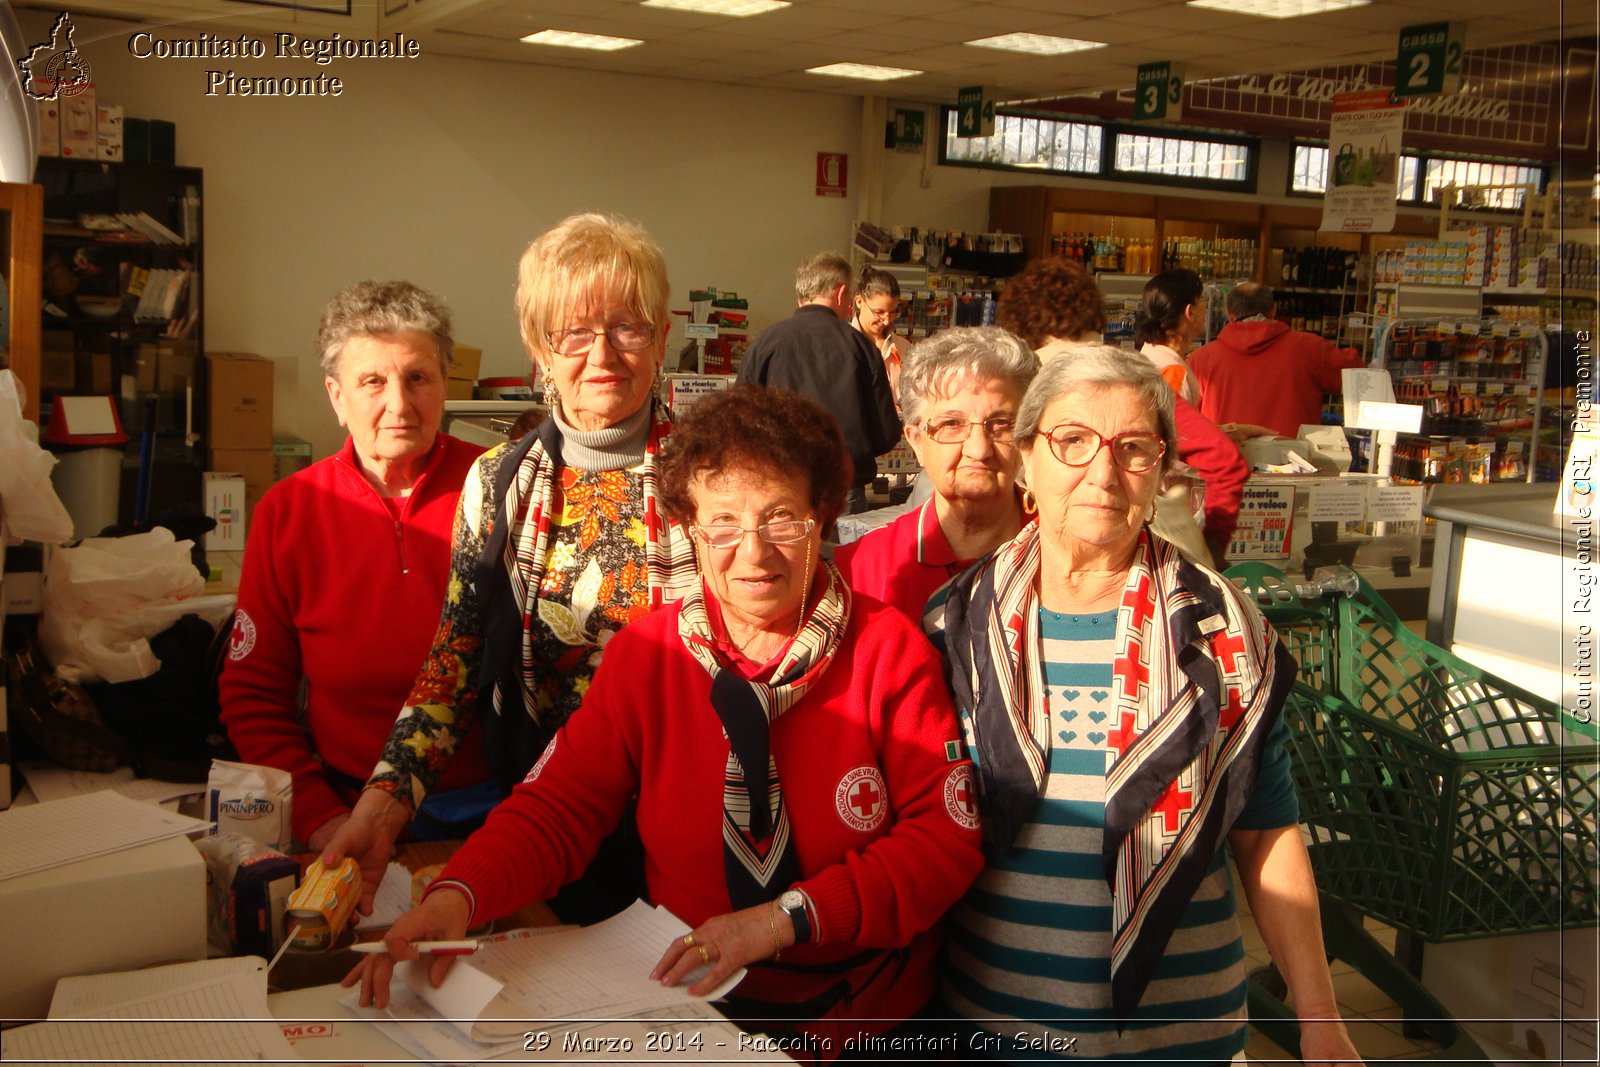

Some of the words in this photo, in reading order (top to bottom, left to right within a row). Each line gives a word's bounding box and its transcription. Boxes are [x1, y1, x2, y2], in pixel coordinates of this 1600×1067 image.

[1401, 30, 1446, 50] cassa
[1407, 52, 1434, 88] 2
[1446, 42, 1462, 75] 2
[1138, 67, 1168, 82] cassa
[1143, 85, 1158, 114] 3
[1169, 76, 1182, 104] 3
[963, 108, 974, 131] 4
[982, 100, 993, 123] 4
[1244, 488, 1279, 499] ricarica
[841, 778, 850, 788] DI
[847, 768, 875, 782] GINEVRA
[950, 772, 957, 781] DI
[219, 802, 275, 814] PININPERO
[837, 787, 865, 830] CONVENZIONE
[945, 780, 968, 825] CONVENZIONE
